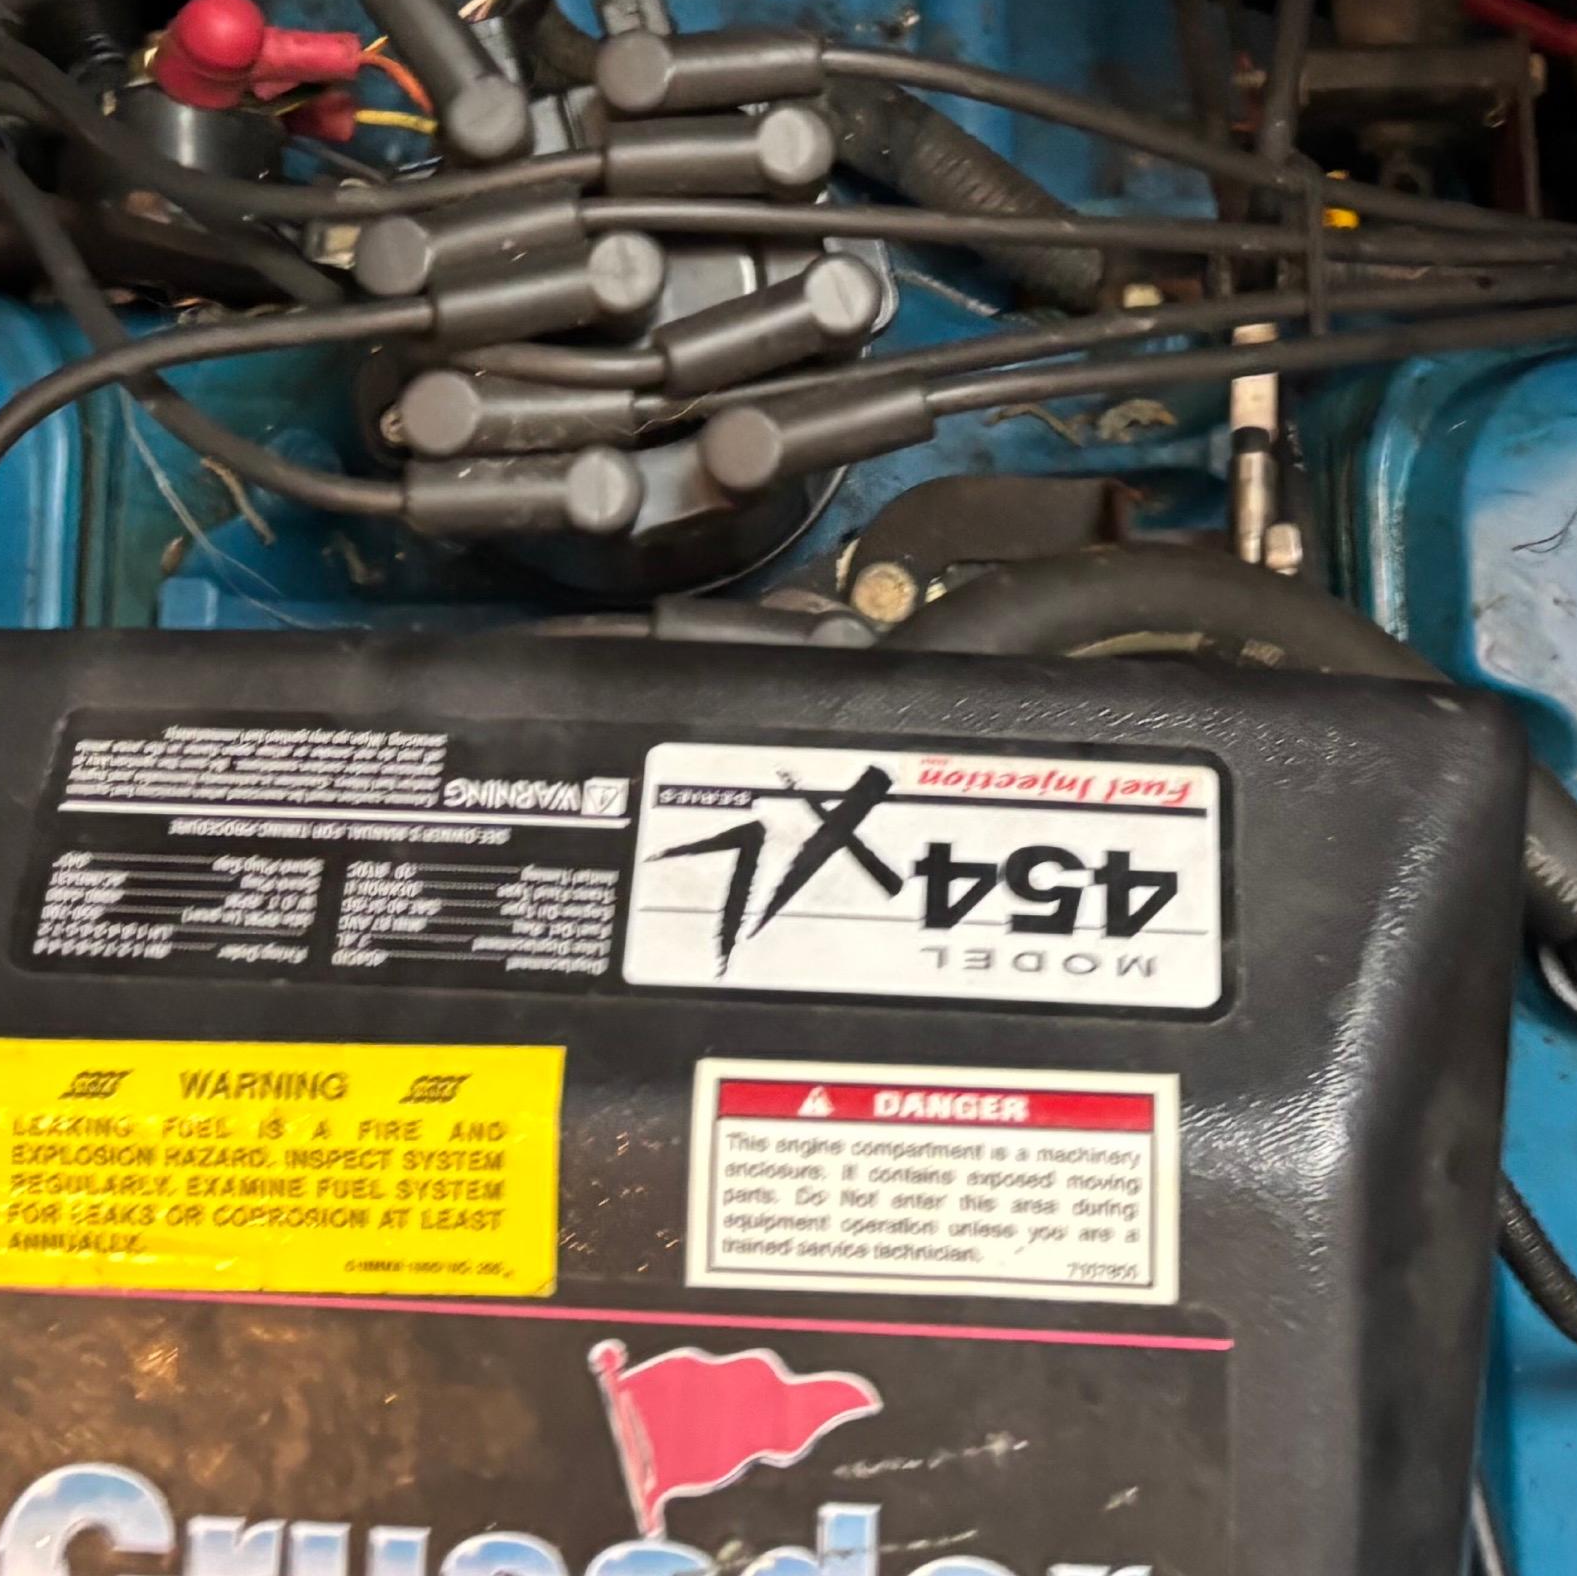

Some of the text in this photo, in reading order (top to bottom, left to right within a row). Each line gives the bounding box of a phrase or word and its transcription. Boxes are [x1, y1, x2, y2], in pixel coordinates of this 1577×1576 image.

[443, 777, 581, 811] WARNING
[658, 787, 753, 807] SERIES
[918, 765, 1192, 807] Fuel Injection
[909, 841, 1178, 938] 454
[920, 947, 1158, 978] MODEL
[179, 1070, 349, 1101] WARNING
[874, 1089, 1029, 1123] DANGER
[12, 1116, 506, 1142] LEAKING FUEL IS A FIRE AND
[11, 1144, 504, 1171] EXPLOSION HAZARD. INSPECT SYSTEM
[726, 1132, 1141, 1170] This engine compartment is a machinery
[10, 1173, 504, 1201] REGULARLY. EXAMINE FUEL SYSTEM
[724, 1161, 1142, 1195] enclosure. It contains exposed moving
[7, 1202, 506, 1230] FOR LEAKS OR CORROSION AT LEAST
[723, 1185, 1139, 1222] parts. Do Not enter this area during
[723, 1213, 1140, 1244] equipment operation unless you are a
[722, 1236, 984, 1262] trained service technician.
